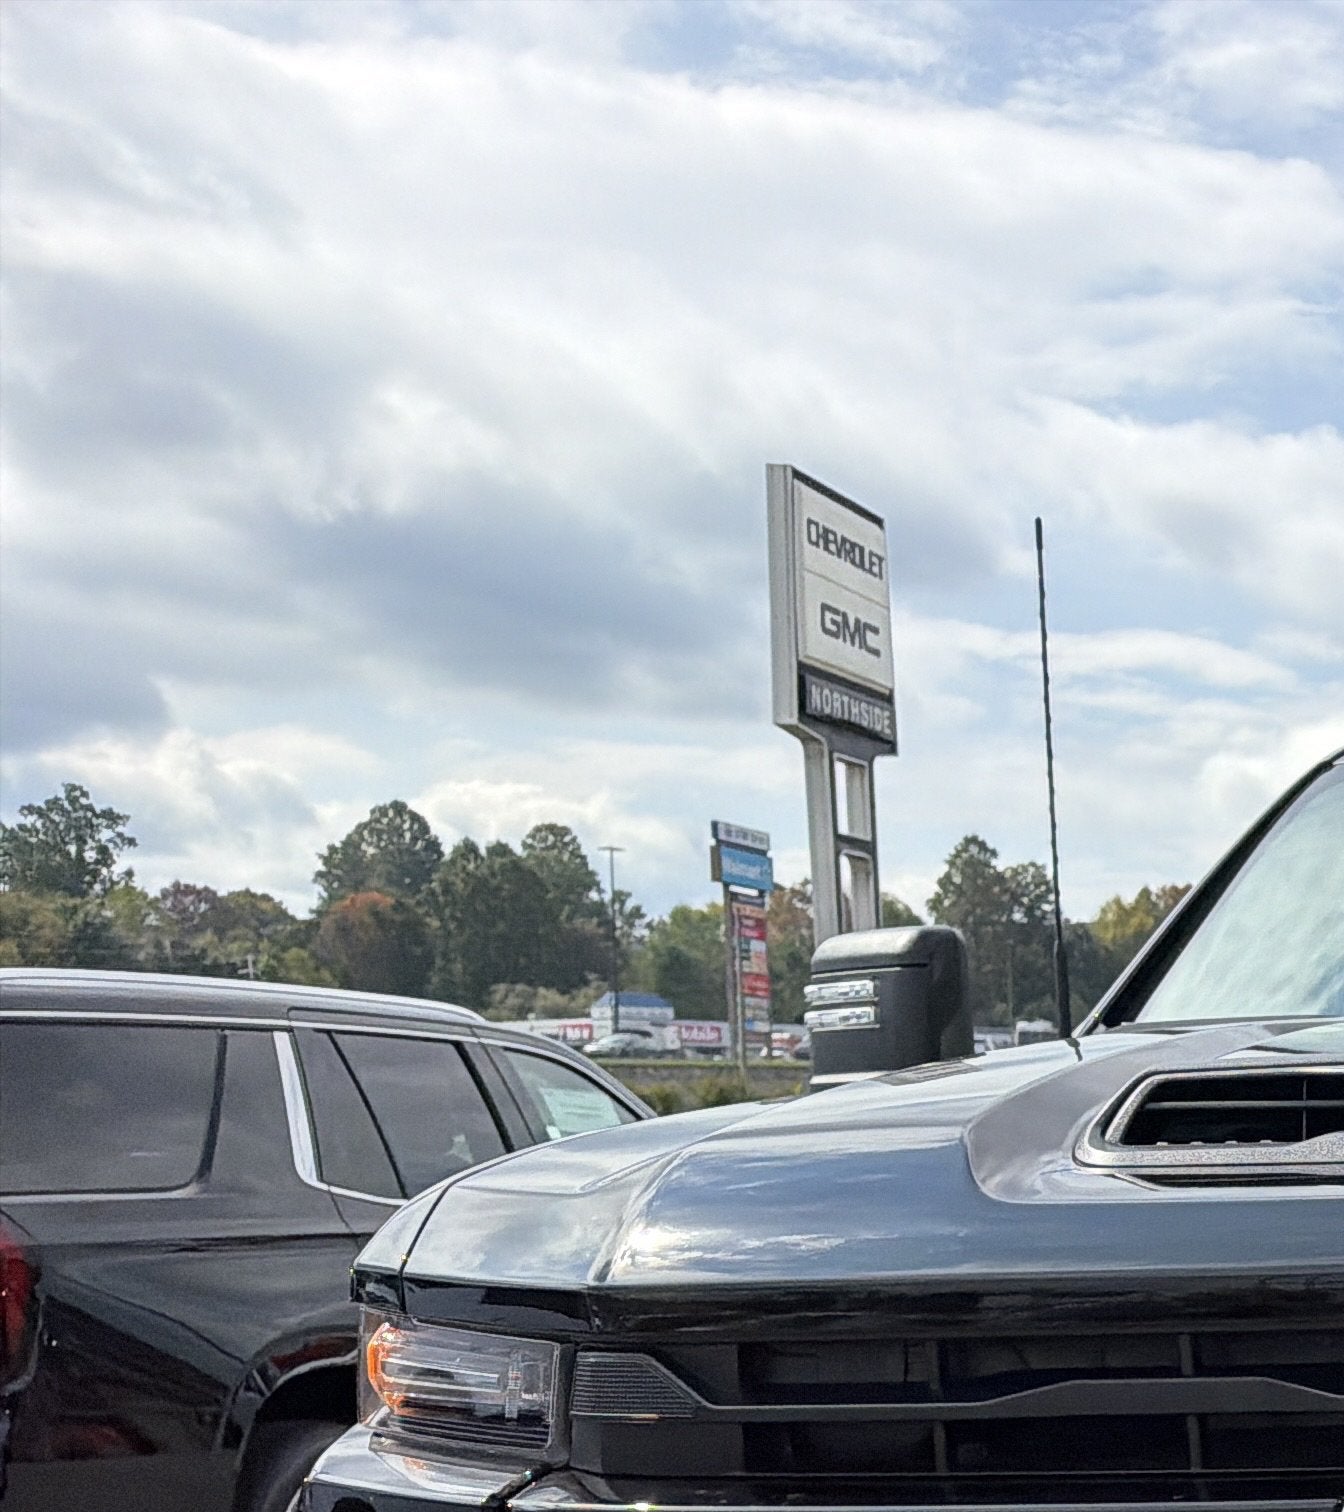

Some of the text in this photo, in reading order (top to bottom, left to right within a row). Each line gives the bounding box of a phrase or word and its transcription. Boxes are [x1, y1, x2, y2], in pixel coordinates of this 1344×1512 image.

[806, 516, 885, 581] CHEVROLET
[820, 601, 881, 659] GMC
[810, 683, 893, 736] NORTHSIDE
